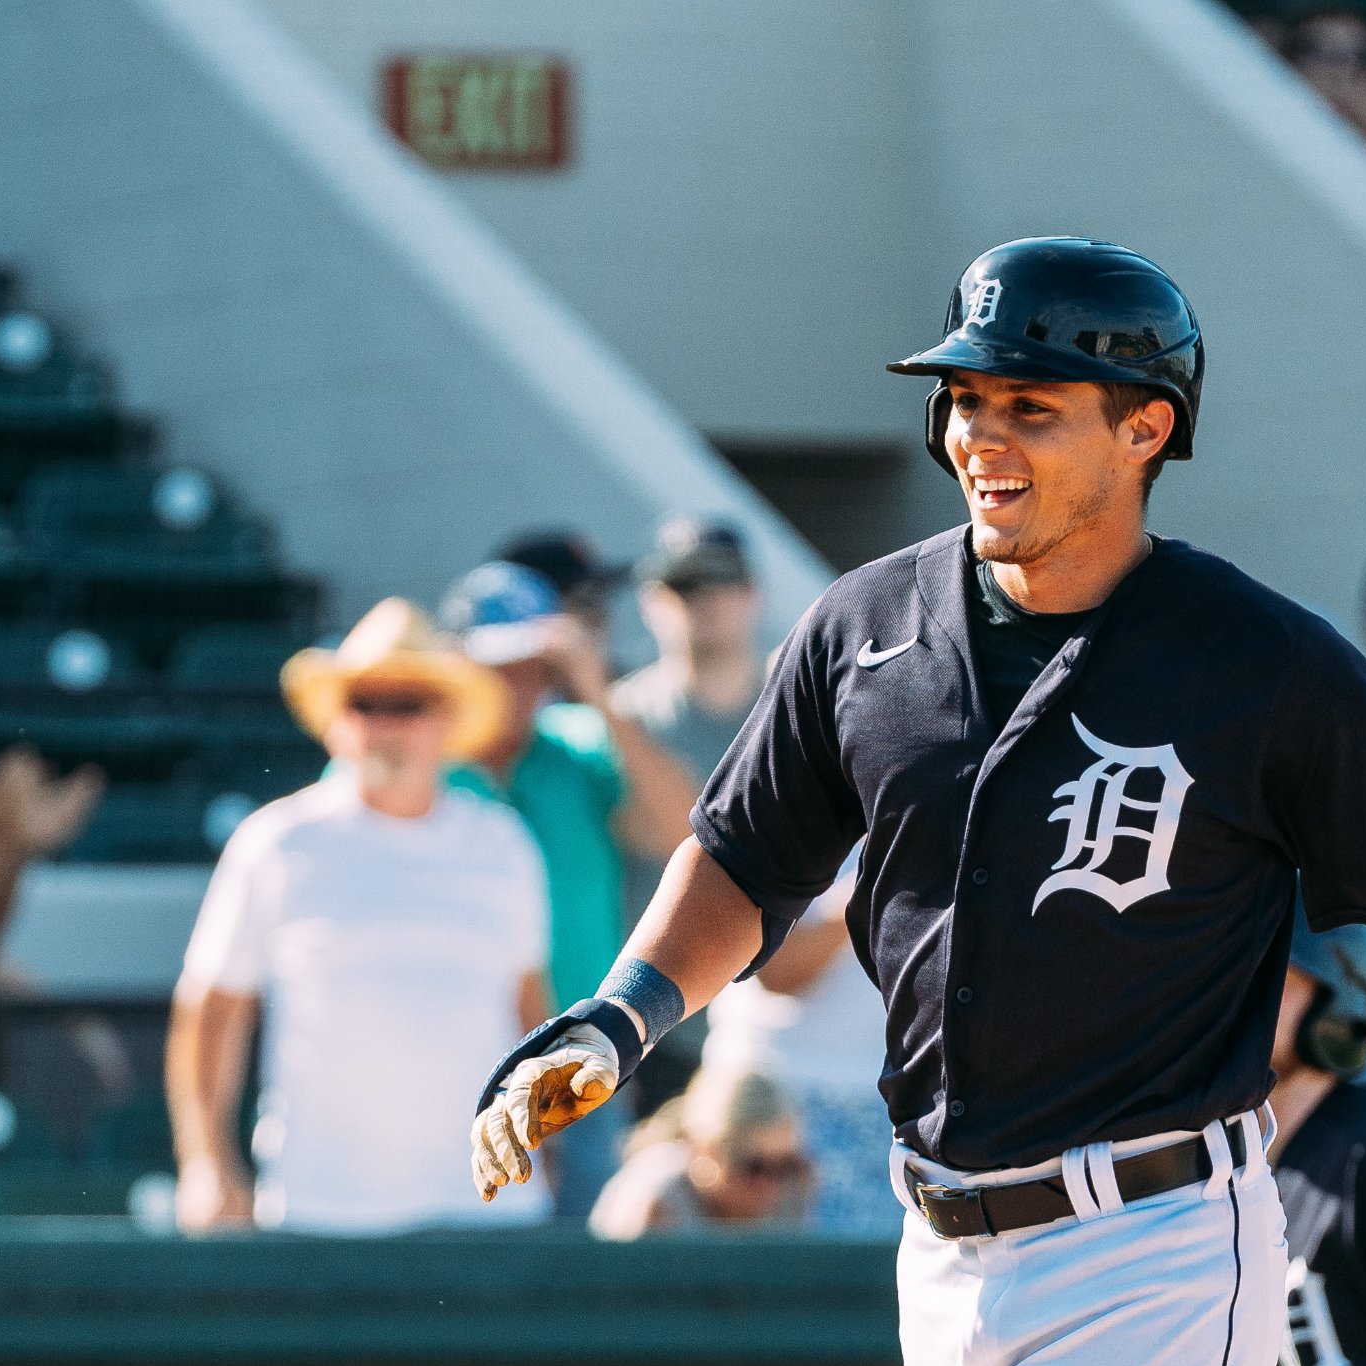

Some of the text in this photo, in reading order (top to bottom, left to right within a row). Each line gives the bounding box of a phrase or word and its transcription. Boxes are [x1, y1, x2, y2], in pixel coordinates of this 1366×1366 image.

[411, 58, 552, 154] EXIT
[961, 273, 1003, 329] D
[1032, 712, 1195, 916] D
